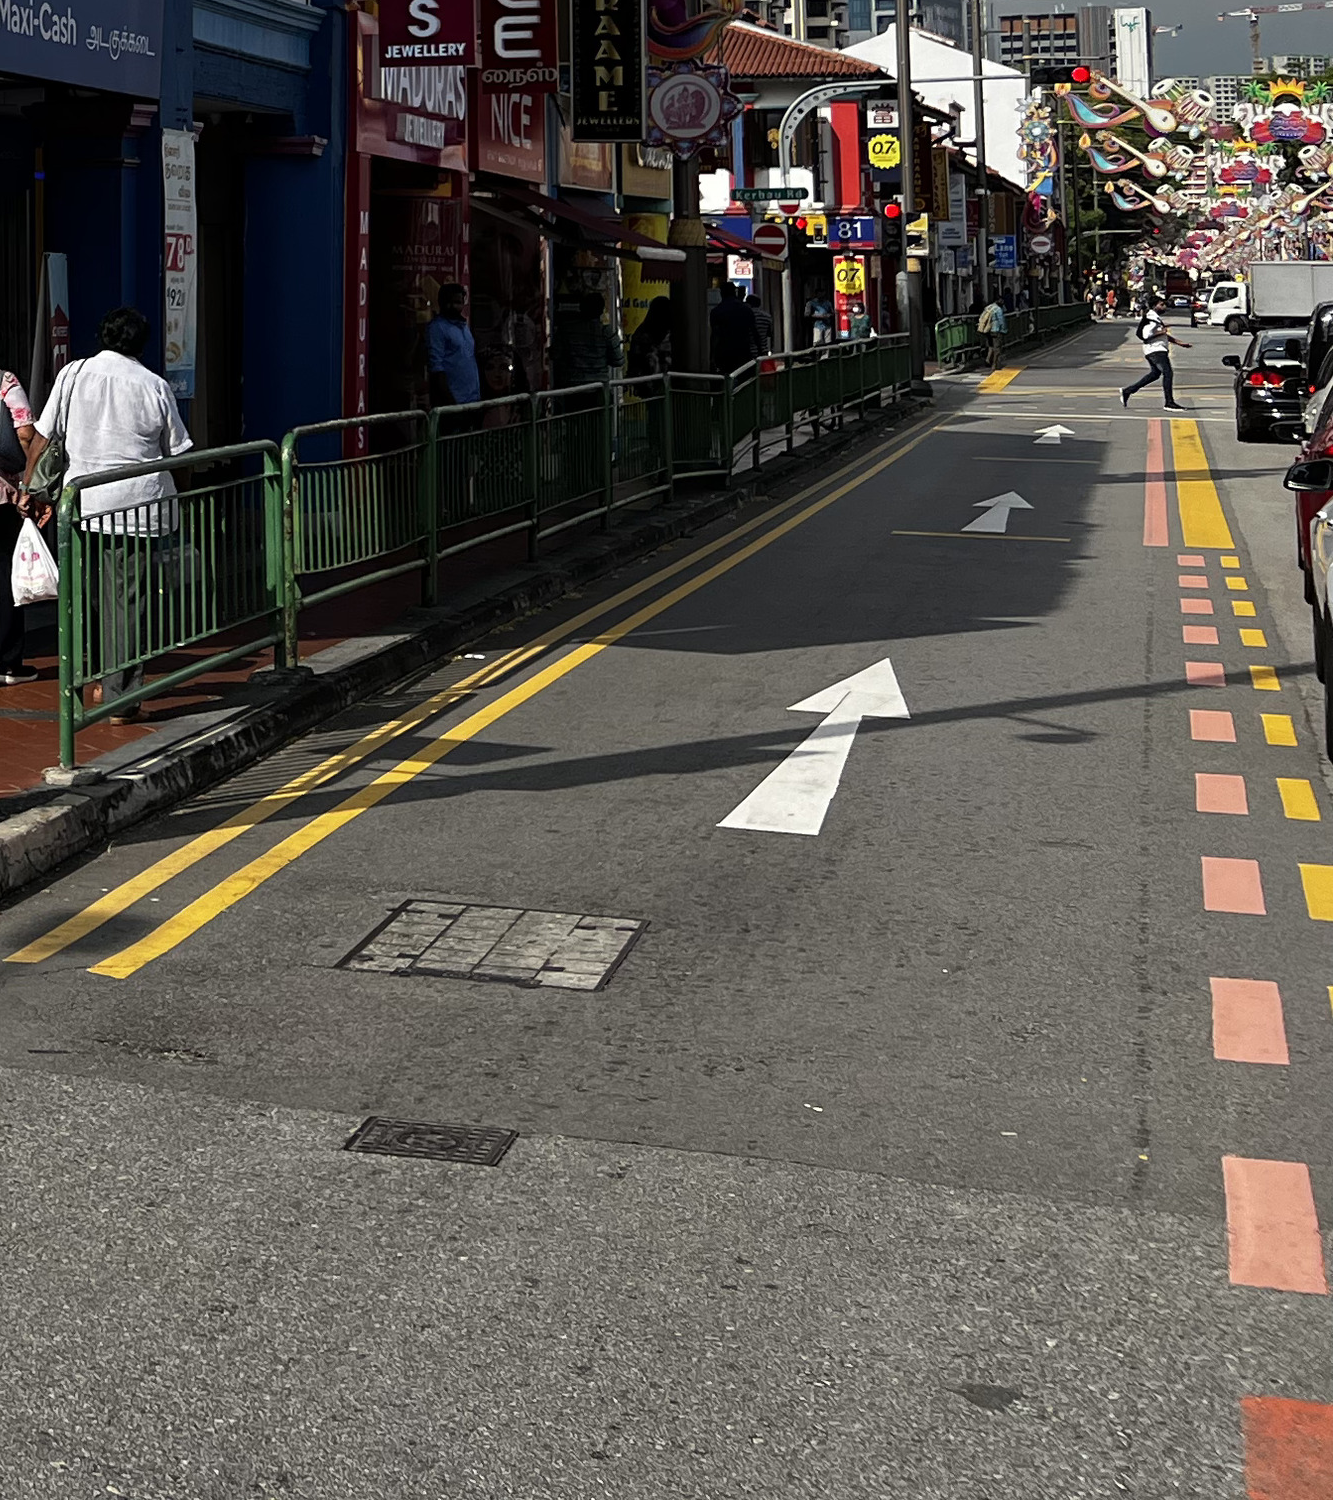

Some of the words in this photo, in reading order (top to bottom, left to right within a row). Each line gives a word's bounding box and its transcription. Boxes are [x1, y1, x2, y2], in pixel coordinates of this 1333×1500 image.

[384, 42, 467, 60] JEWELLERY
[381, 65, 465, 121] MADURAS
[492, 92, 533, 150] NICE
[735, 190, 781, 200] Kerbau
[787, 189, 803, 200] Rd
[838, 221, 862, 239] 81
[357, 210, 369, 448] MADURAS
